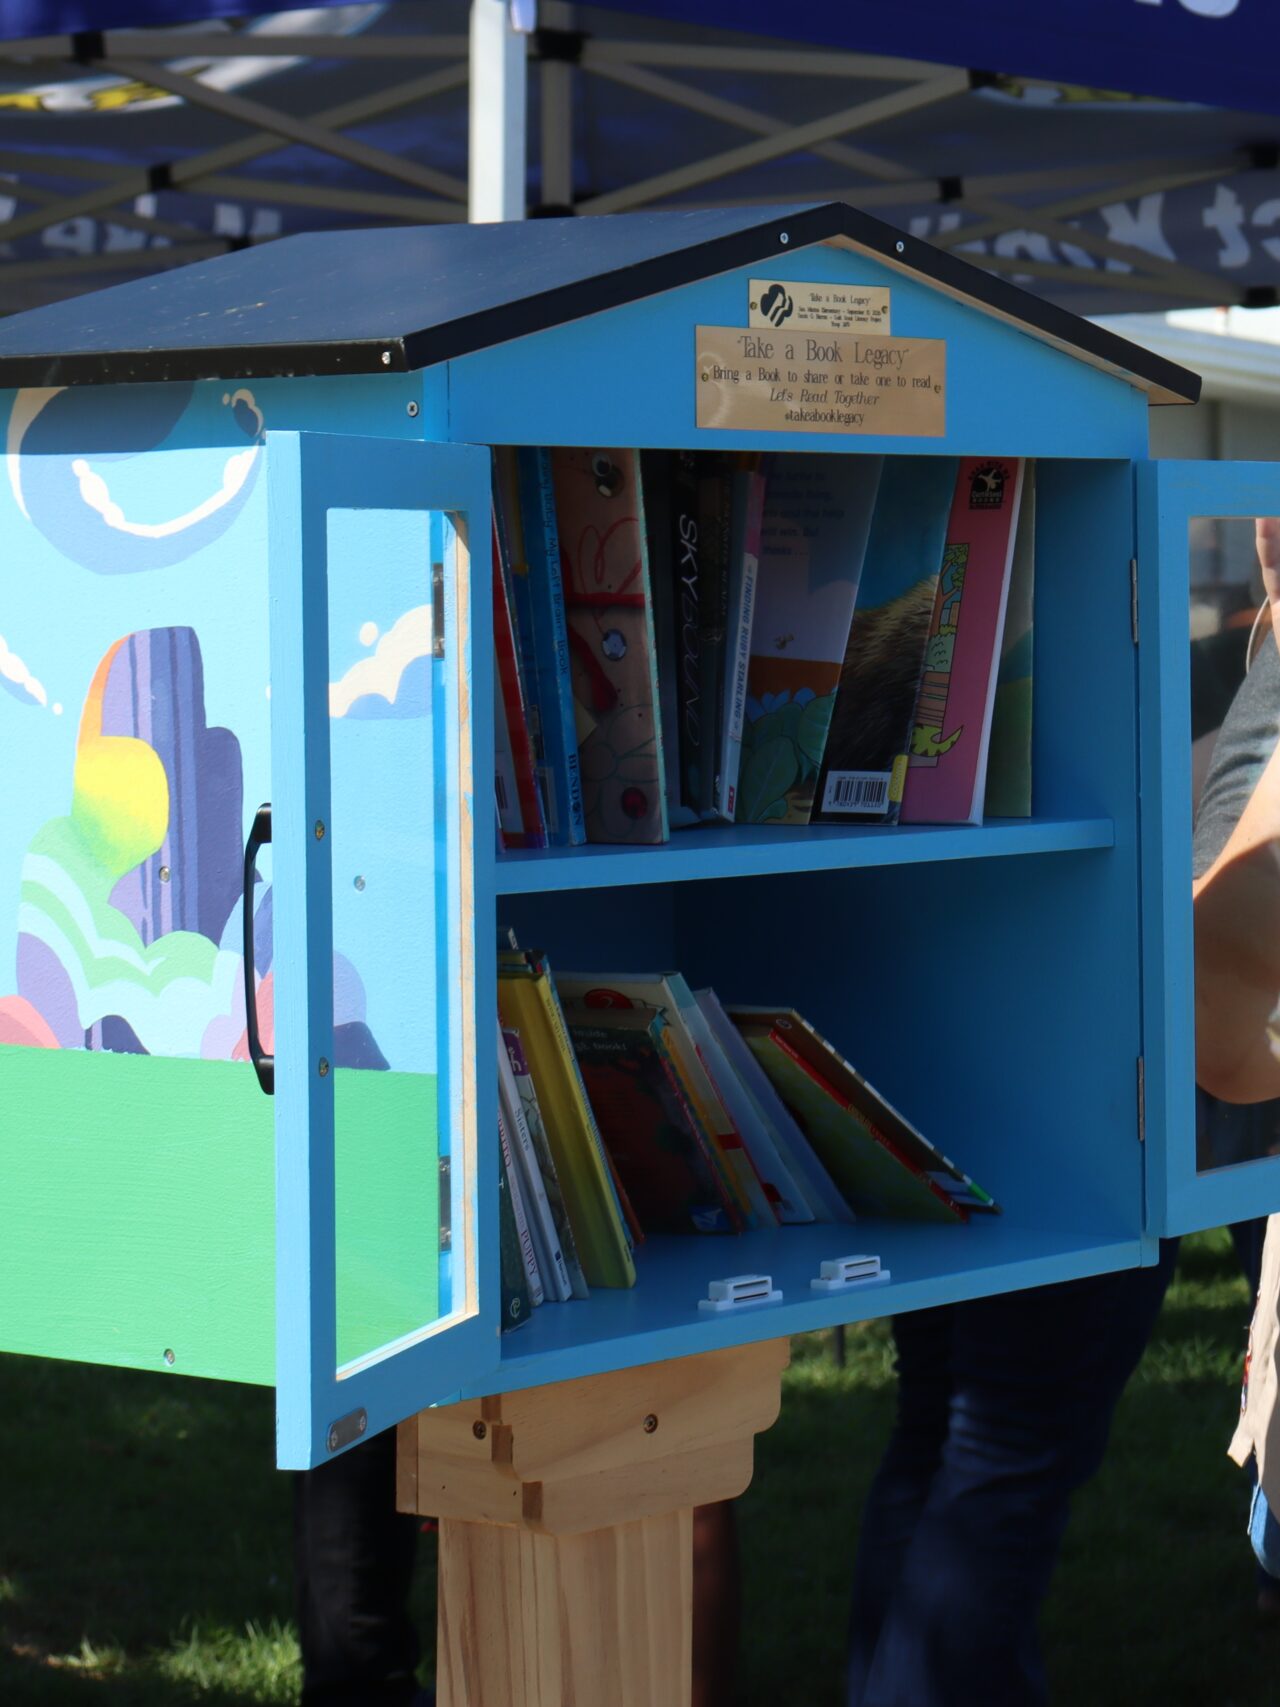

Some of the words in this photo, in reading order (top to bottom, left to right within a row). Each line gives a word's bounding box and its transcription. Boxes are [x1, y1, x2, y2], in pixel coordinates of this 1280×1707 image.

[785, 343, 795, 361] a
[806, 339, 843, 363] Book
[713, 365, 740, 384] Bring
[745, 370, 752, 381] a
[758, 368, 781, 382] Book
[787, 370, 798, 383] to
[803, 369, 829, 384] share
[834, 374, 844, 385] or
[850, 372, 870, 386] take
[876, 376, 892, 388] one
[897, 374, 907, 387] to
[912, 375, 931, 389] read
[800, 389, 827, 404] Read
[834, 390, 880, 407] Together
[740, 575, 753, 625] FINDING
[679, 512, 700, 748] SKYBOUND
[738, 627, 749, 660] RUBY
[733, 661, 746, 720] STARLING
[514, 1106, 531, 1153] Sisters
[520, 1229, 539, 1277] PUPPY
